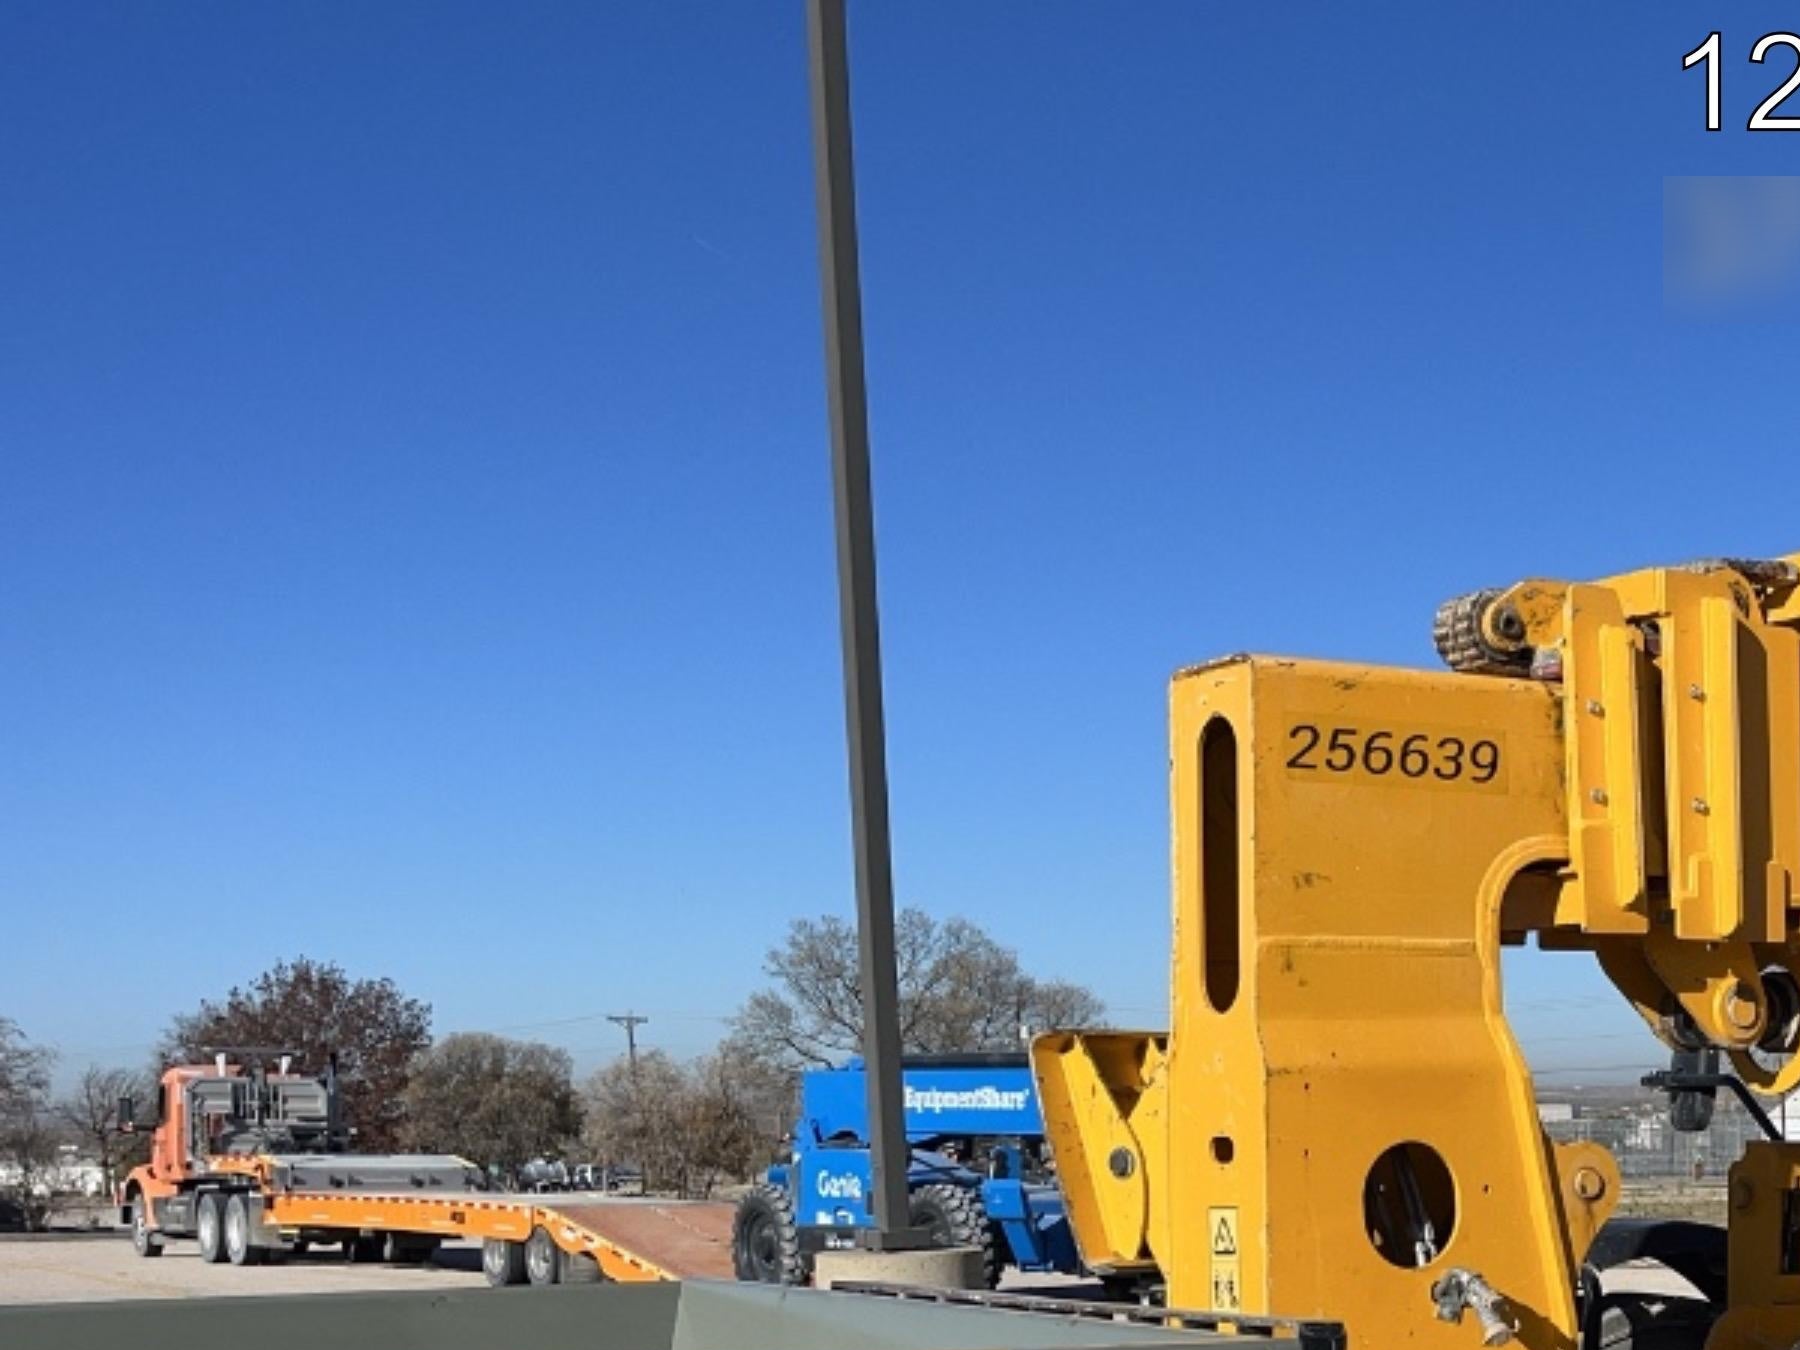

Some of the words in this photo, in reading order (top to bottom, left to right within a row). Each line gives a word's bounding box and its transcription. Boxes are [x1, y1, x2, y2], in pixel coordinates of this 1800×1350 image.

[1286, 725, 1499, 784] 256639
[904, 1085, 1027, 1114] EquipmentShare
[817, 1169, 862, 1199] Genie
